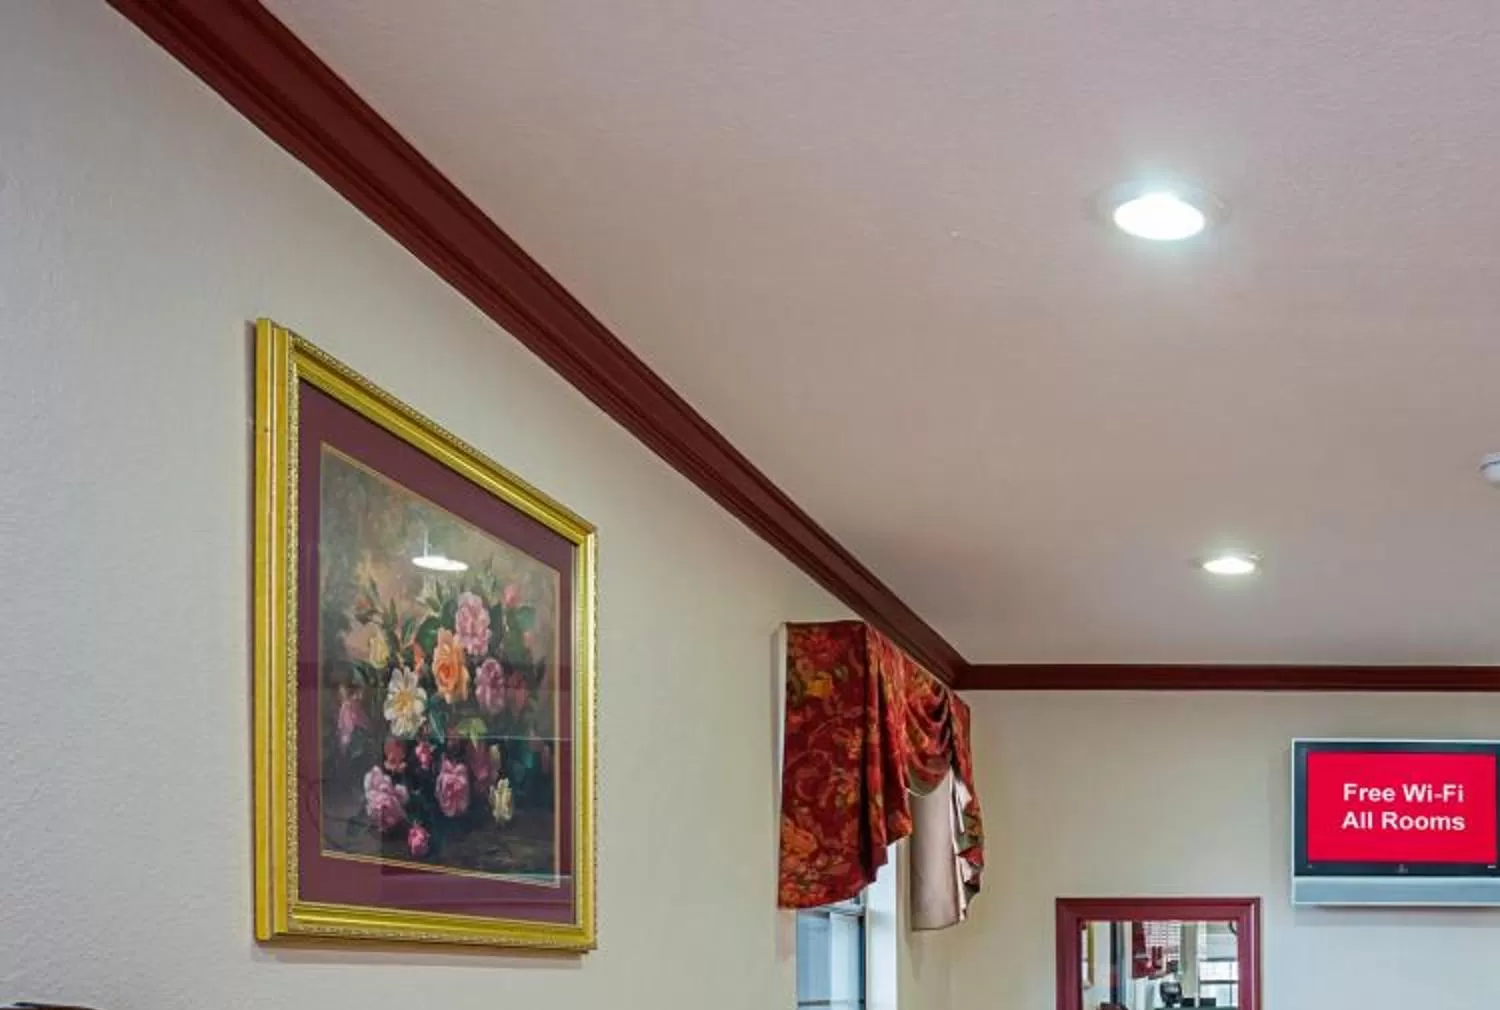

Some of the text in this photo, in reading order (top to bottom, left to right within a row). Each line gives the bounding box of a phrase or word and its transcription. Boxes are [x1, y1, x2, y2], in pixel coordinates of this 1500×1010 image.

[1343, 783, 1464, 803] Free Wi-Fi
[1341, 811, 1465, 831] All Rooms
